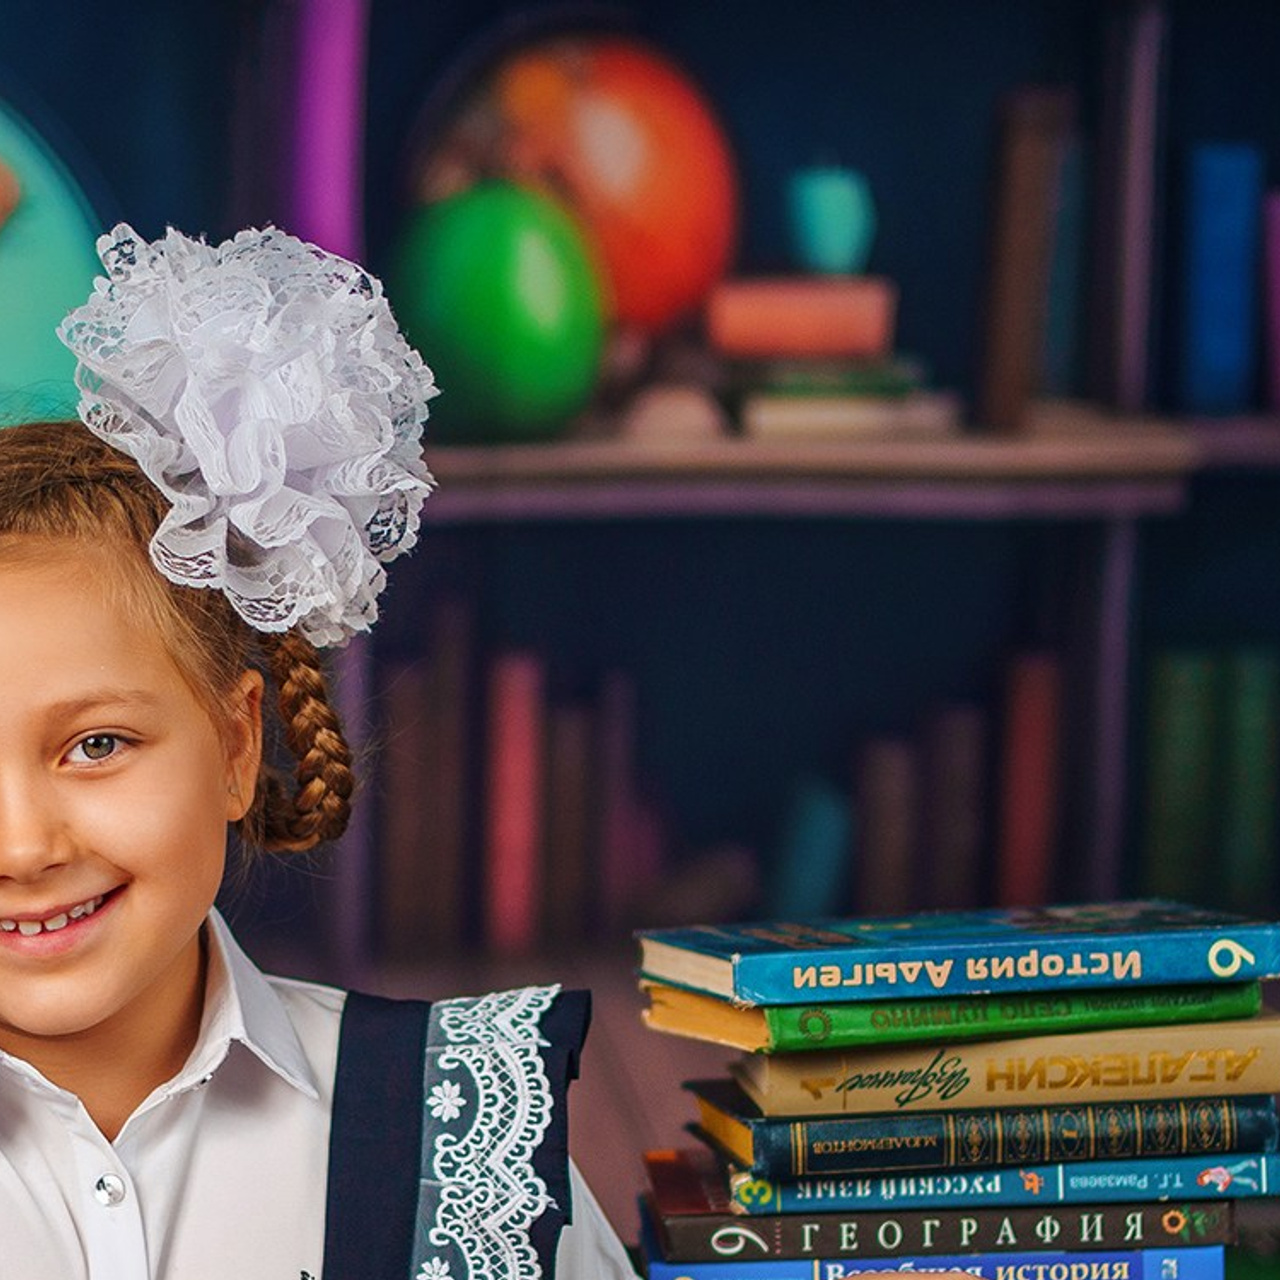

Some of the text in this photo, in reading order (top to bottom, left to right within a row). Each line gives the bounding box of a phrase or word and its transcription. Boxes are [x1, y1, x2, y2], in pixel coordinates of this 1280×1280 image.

[792, 949, 1143, 989] История Адыгеи
[835, 1050, 970, 1104] Избранное
[796, 1174, 1002, 1200] РУССКИЙ ЯЗЫК
[1069, 1173, 1149, 1190] Рамзаева
[801, 1211, 1144, 1251] ГЕОГРАФИЯ
